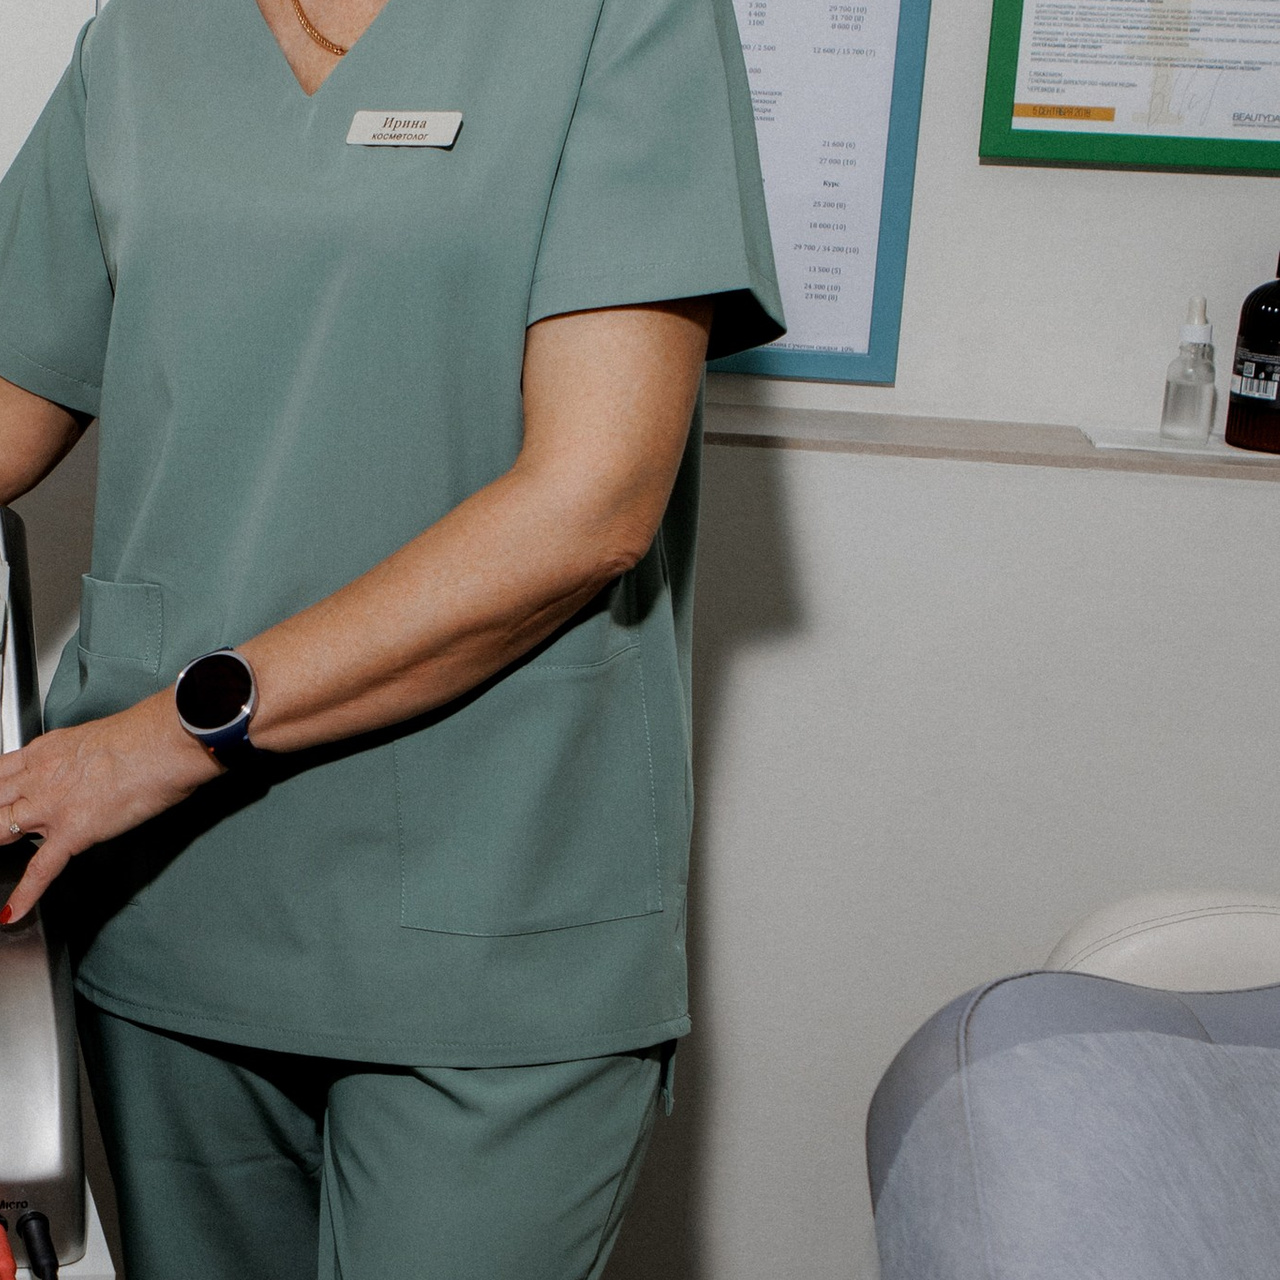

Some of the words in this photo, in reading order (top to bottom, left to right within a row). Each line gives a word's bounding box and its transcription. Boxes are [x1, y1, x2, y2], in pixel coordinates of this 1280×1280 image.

[382, 117, 427, 131] Ирина
[371, 132, 428, 140] косметолог
[823, 180, 840, 188] Курс
